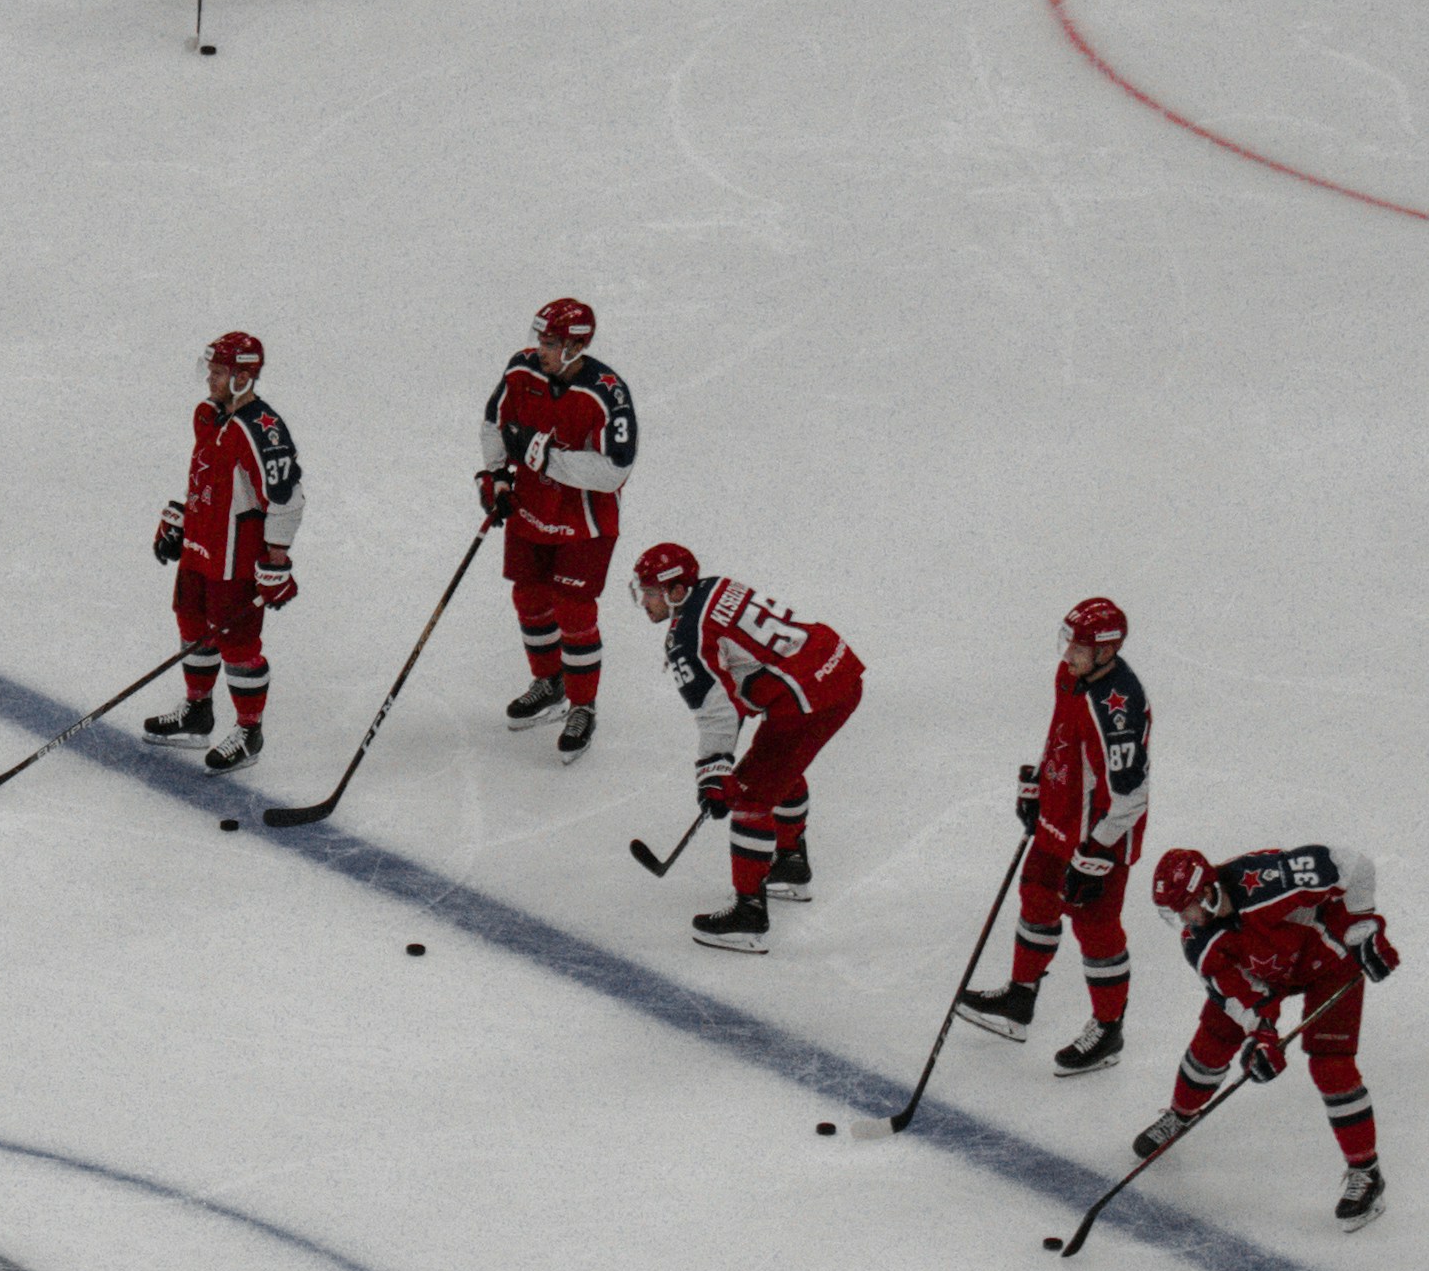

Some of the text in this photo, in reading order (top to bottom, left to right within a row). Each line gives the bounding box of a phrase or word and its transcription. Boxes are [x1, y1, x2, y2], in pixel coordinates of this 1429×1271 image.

[613, 416, 630, 445] 3
[265, 456, 292, 487] 37
[1108, 742, 1135, 773] 87
[1287, 854, 1320, 887] 35
